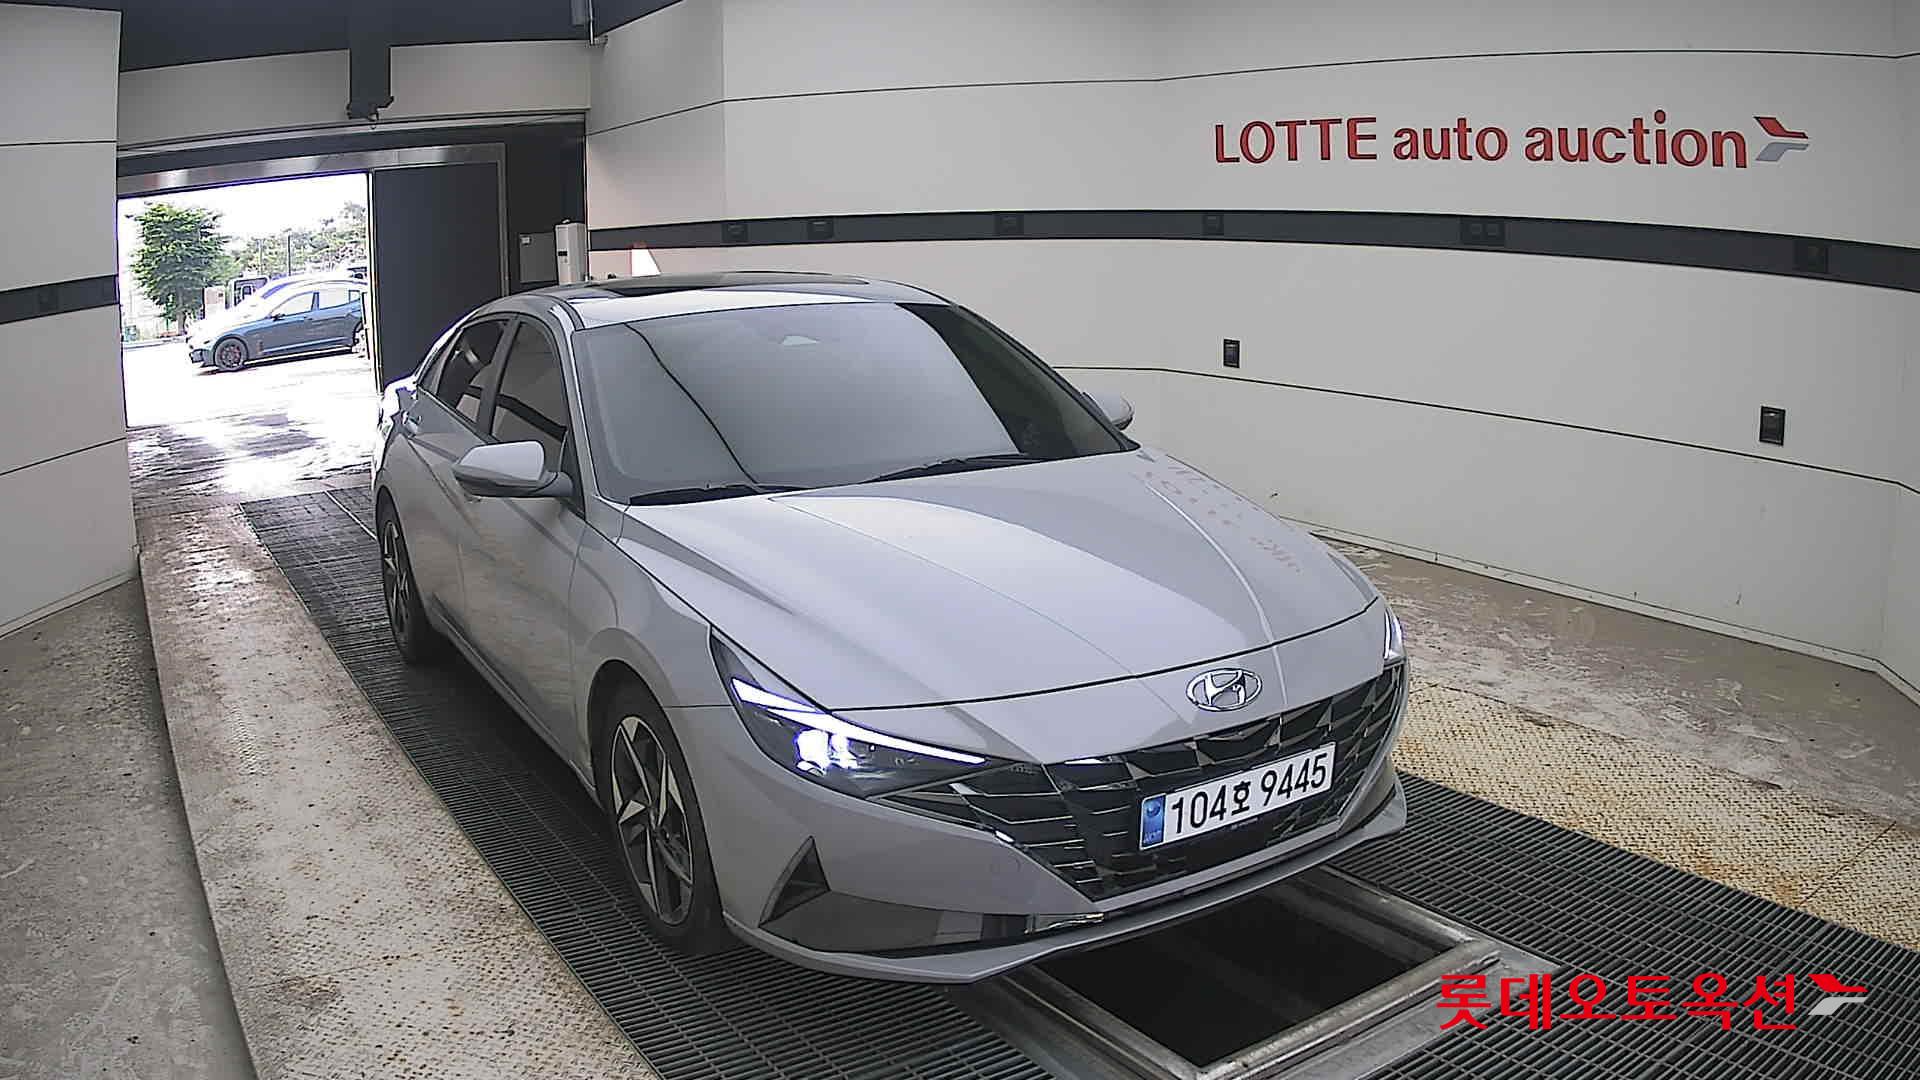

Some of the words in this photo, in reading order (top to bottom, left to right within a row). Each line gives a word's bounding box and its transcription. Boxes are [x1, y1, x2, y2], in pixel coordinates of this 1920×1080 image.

[1214, 116, 1377, 164] LOTTE
[1392, 117, 1509, 162] auto
[1524, 109, 1748, 169] auction
[1171, 780, 1251, 834] 104호
[1261, 752, 1328, 807] 9445
